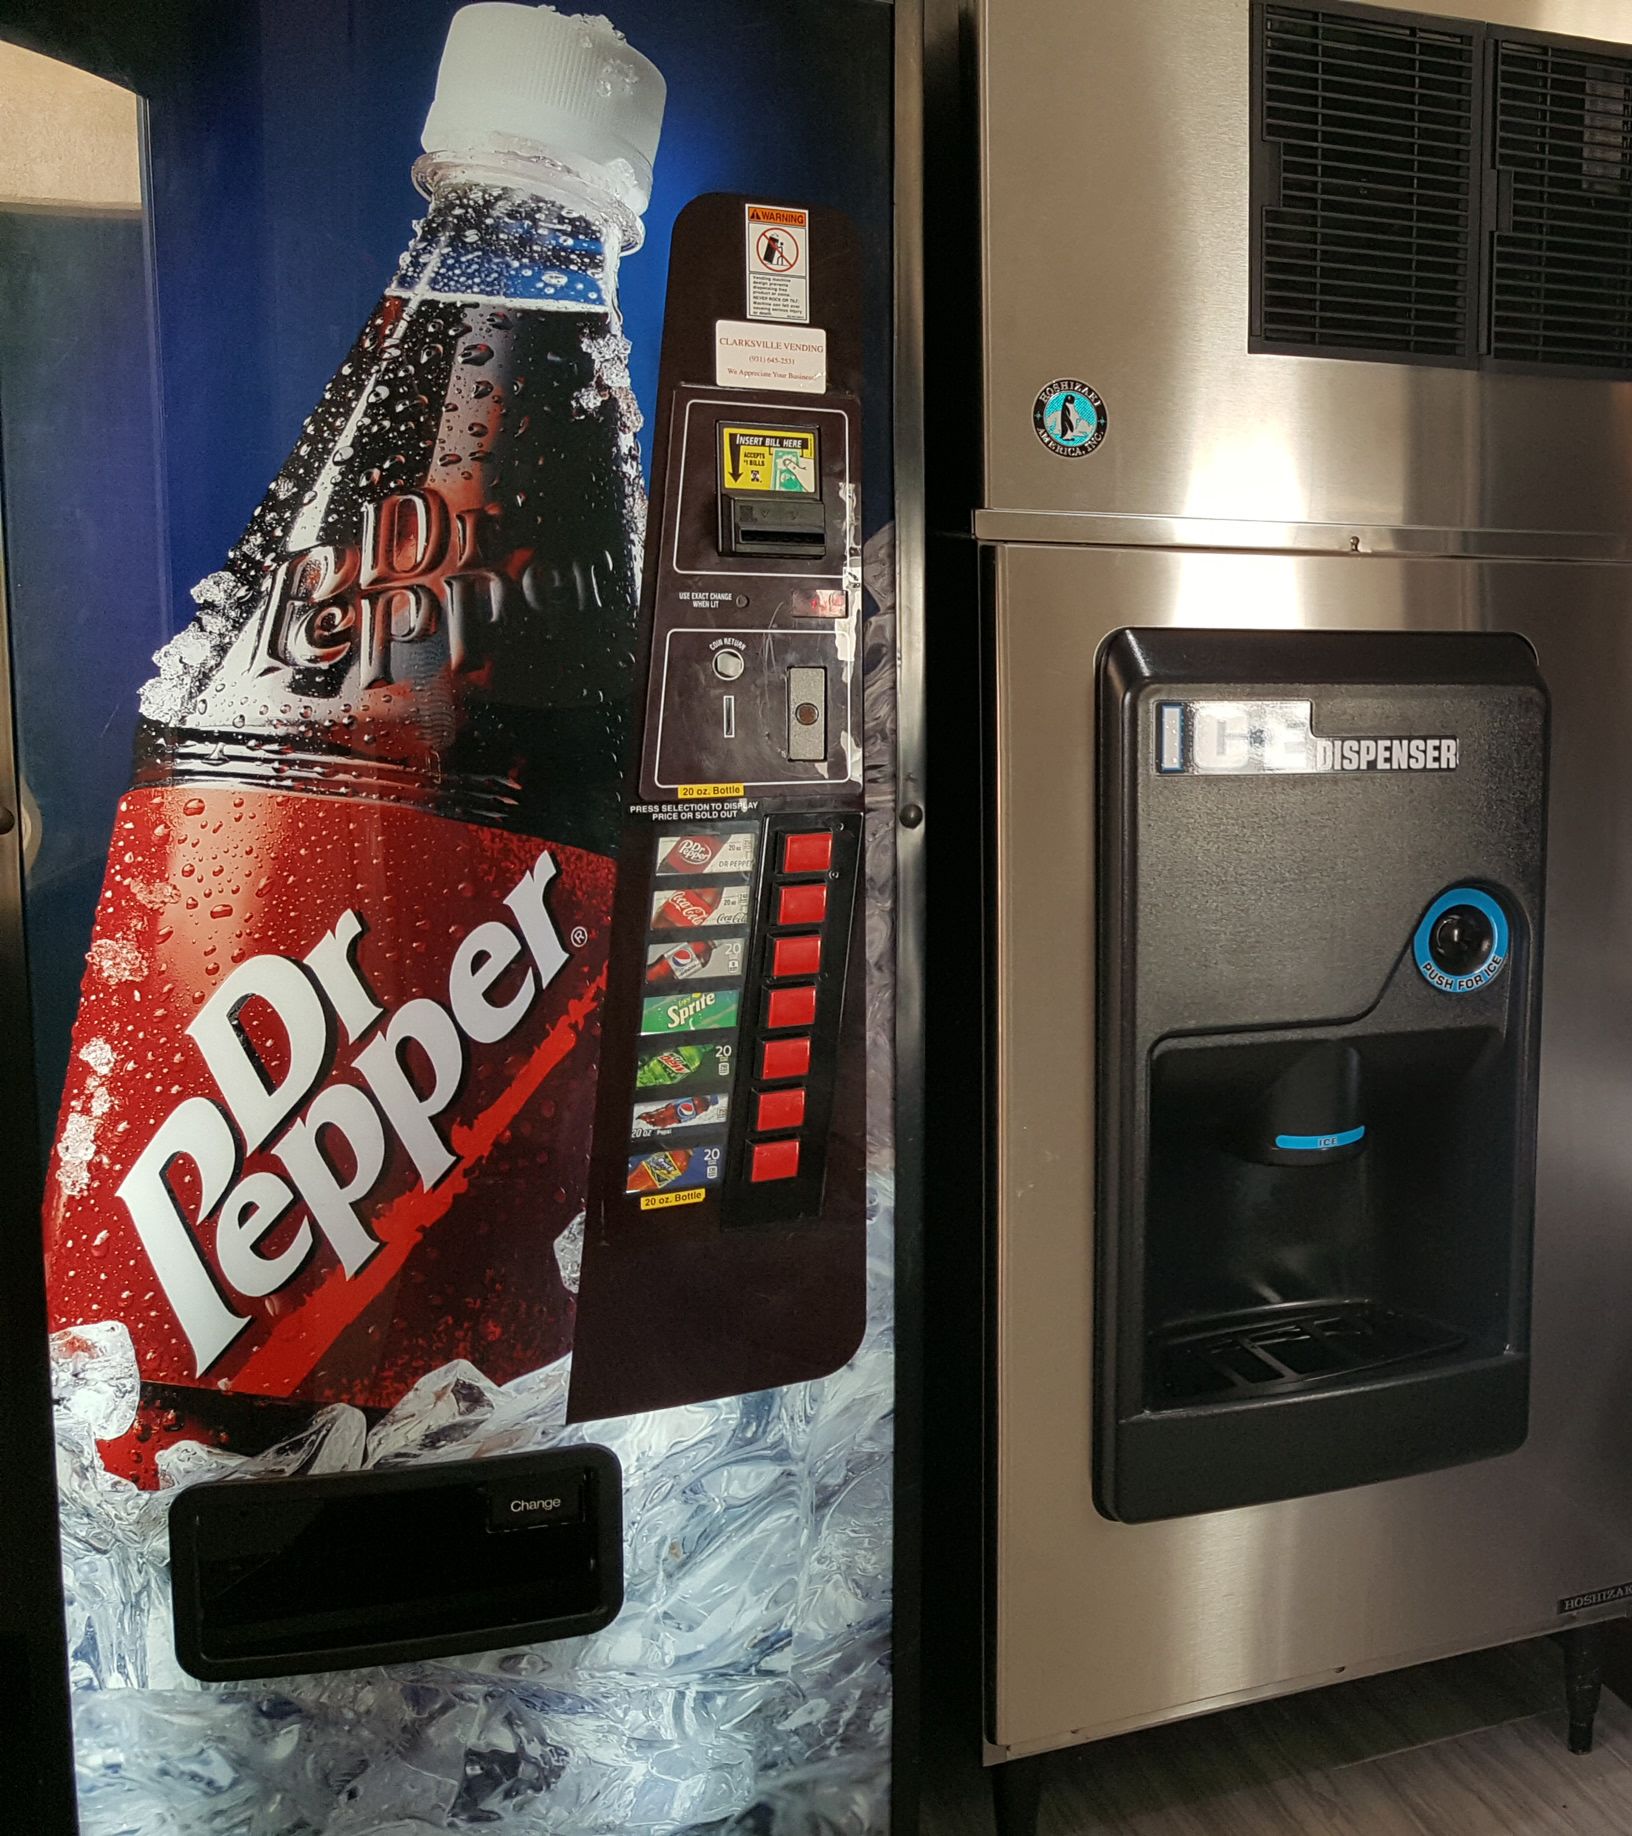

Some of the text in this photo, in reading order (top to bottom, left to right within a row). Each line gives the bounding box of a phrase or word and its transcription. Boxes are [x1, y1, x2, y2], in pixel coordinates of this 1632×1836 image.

[761, 211, 804, 225] WARNING
[720, 338, 824, 353] CLARKSVILLE VENDING
[767, 357, 795, 365] 645-2531
[740, 370, 771, 378] Appreciate
[1039, 381, 1102, 406] HOSHIZAKI
[765, 437, 780, 447] BILL
[783, 438, 802, 448] HERE
[744, 451, 765, 459] ACCEPTS
[679, 592, 690, 600] USE
[691, 592, 709, 600] EXACT
[709, 638, 746, 651] COIN RETURN
[1316, 738, 1457, 771] DISPENSER
[683, 787, 694, 796] 20
[713, 786, 740, 795] Bottle
[630, 801, 758, 813] PRESS SELECTION TO DISPLAY
[652, 810, 737, 821] PRICE OR SOLD OUT
[678, 840, 708, 860] Pepper
[669, 891, 707, 926] Coca-Cola
[725, 943, 741, 955] 20
[1422, 955, 1502, 991] PUSH FOR ICE
[667, 992, 715, 1028] Sprite
[715, 1045, 732, 1057] 20
[116, 849, 571, 1378] Dr Pepper
[631, 1129, 643, 1138] 20
[1320, 1137, 1337, 1146] ICE
[704, 1148, 720, 1161] 20
[645, 1191, 702, 1206] 20 oz. Bottle
[510, 1498, 561, 1512] Change
